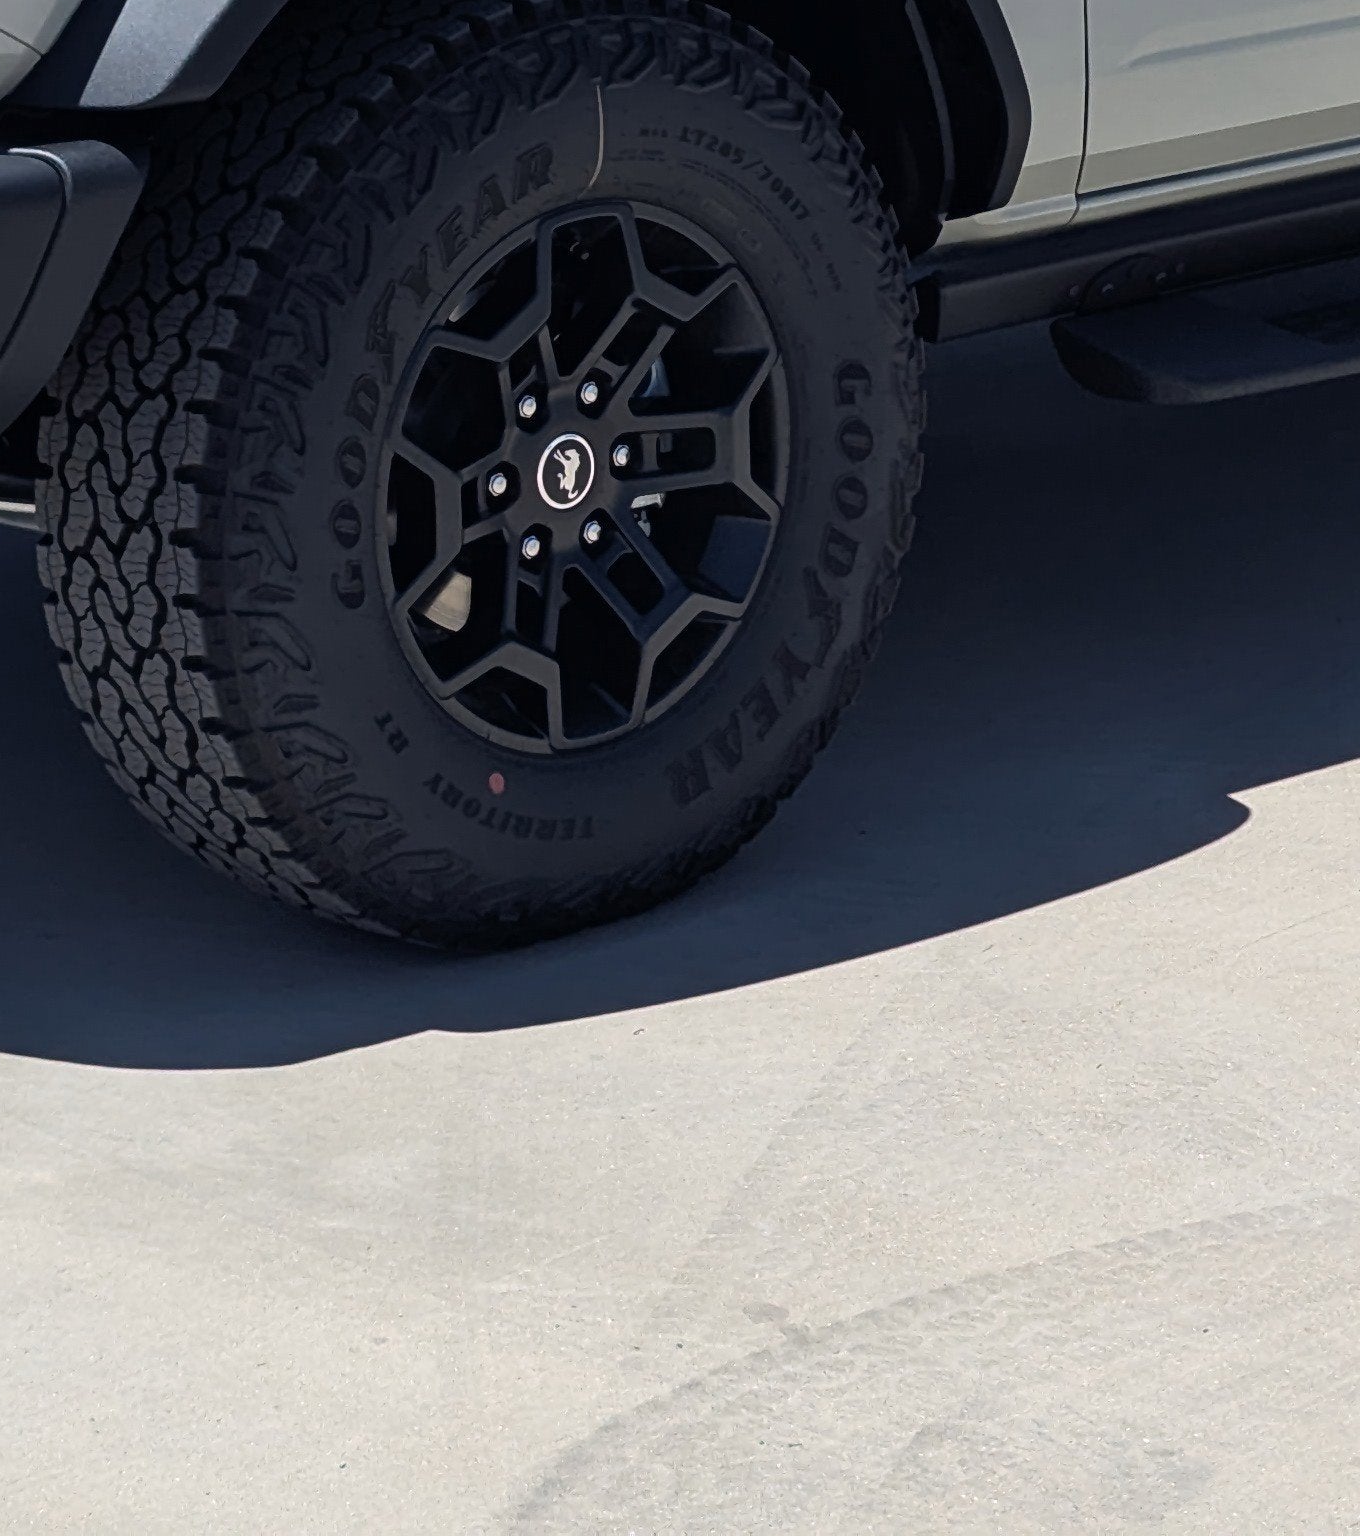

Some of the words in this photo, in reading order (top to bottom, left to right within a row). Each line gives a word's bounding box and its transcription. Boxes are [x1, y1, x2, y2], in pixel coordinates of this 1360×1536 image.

[329, 141, 555, 611] GOODYEAR
[663, 357, 875, 810] GOODYEAR
[422, 772, 596, 842] TERRITORY
